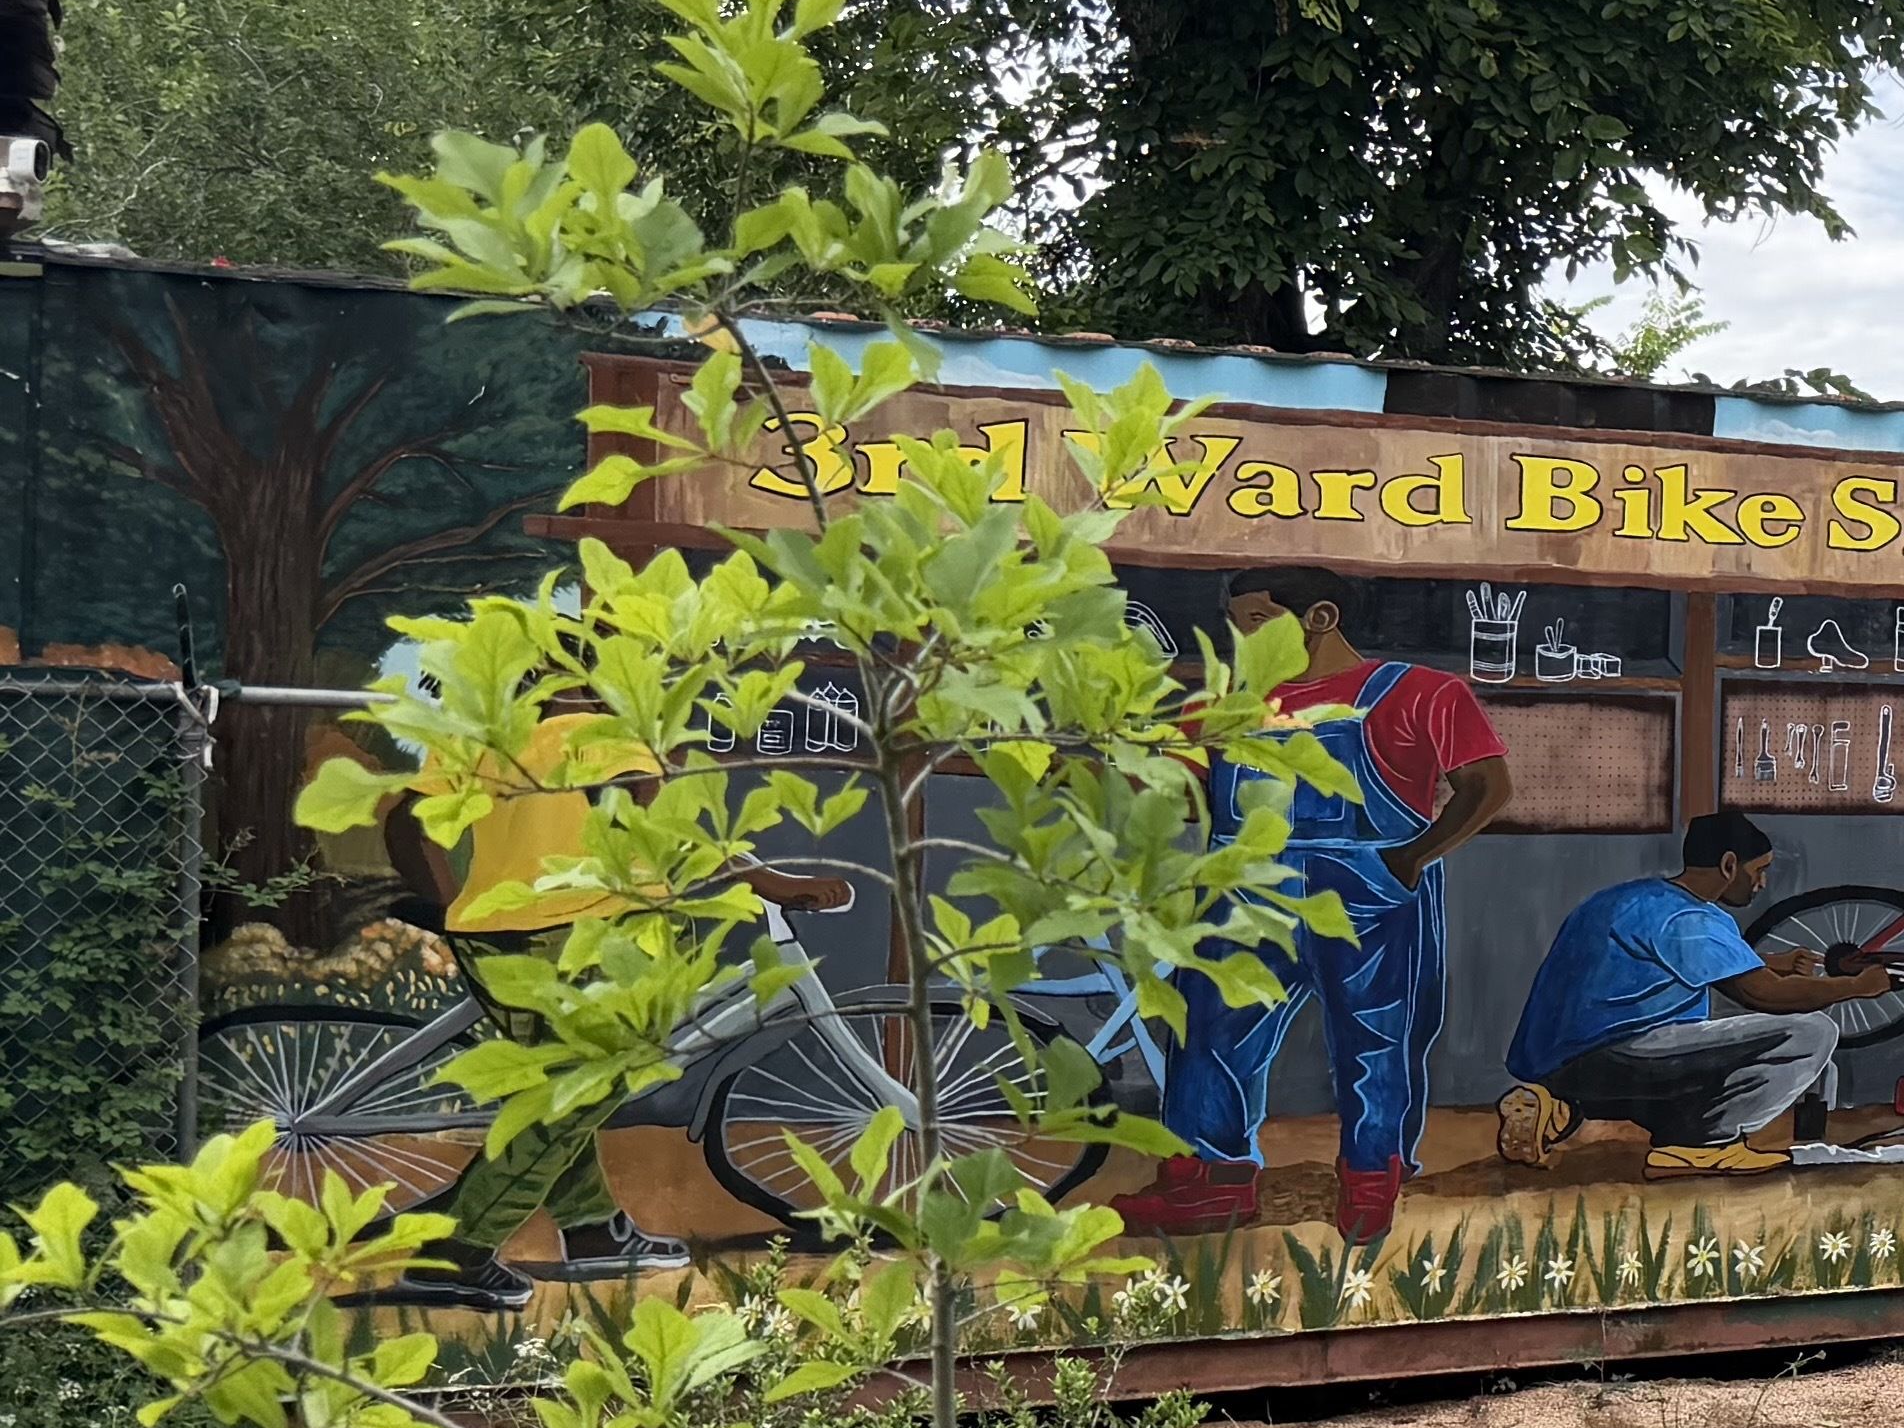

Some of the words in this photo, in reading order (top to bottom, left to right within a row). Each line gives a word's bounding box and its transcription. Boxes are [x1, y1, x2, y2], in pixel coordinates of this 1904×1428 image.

[750, 412, 1029, 503] 3rd
[1063, 428, 1472, 527] Ward
[1505, 453, 1805, 547] Bike
